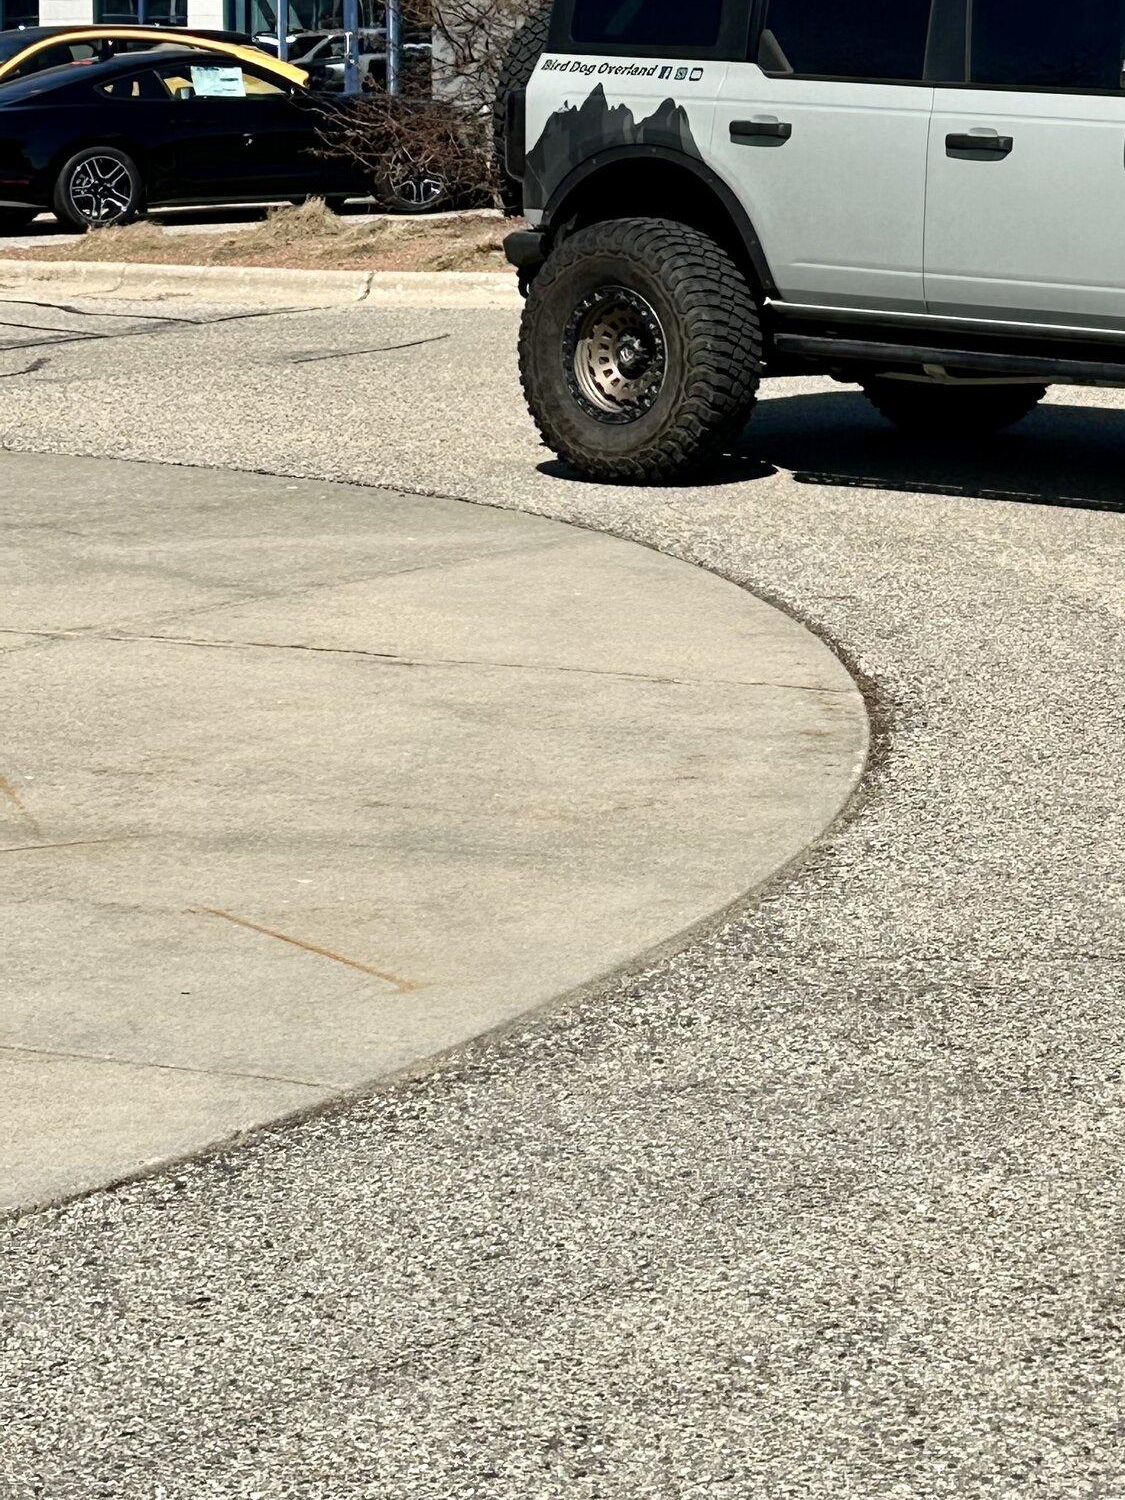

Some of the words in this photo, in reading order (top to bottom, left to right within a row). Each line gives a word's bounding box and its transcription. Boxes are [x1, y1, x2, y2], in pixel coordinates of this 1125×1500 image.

[541, 59, 571, 71] Bird
[569, 61, 597, 76] Dog
[597, 62, 659, 77] Overland
